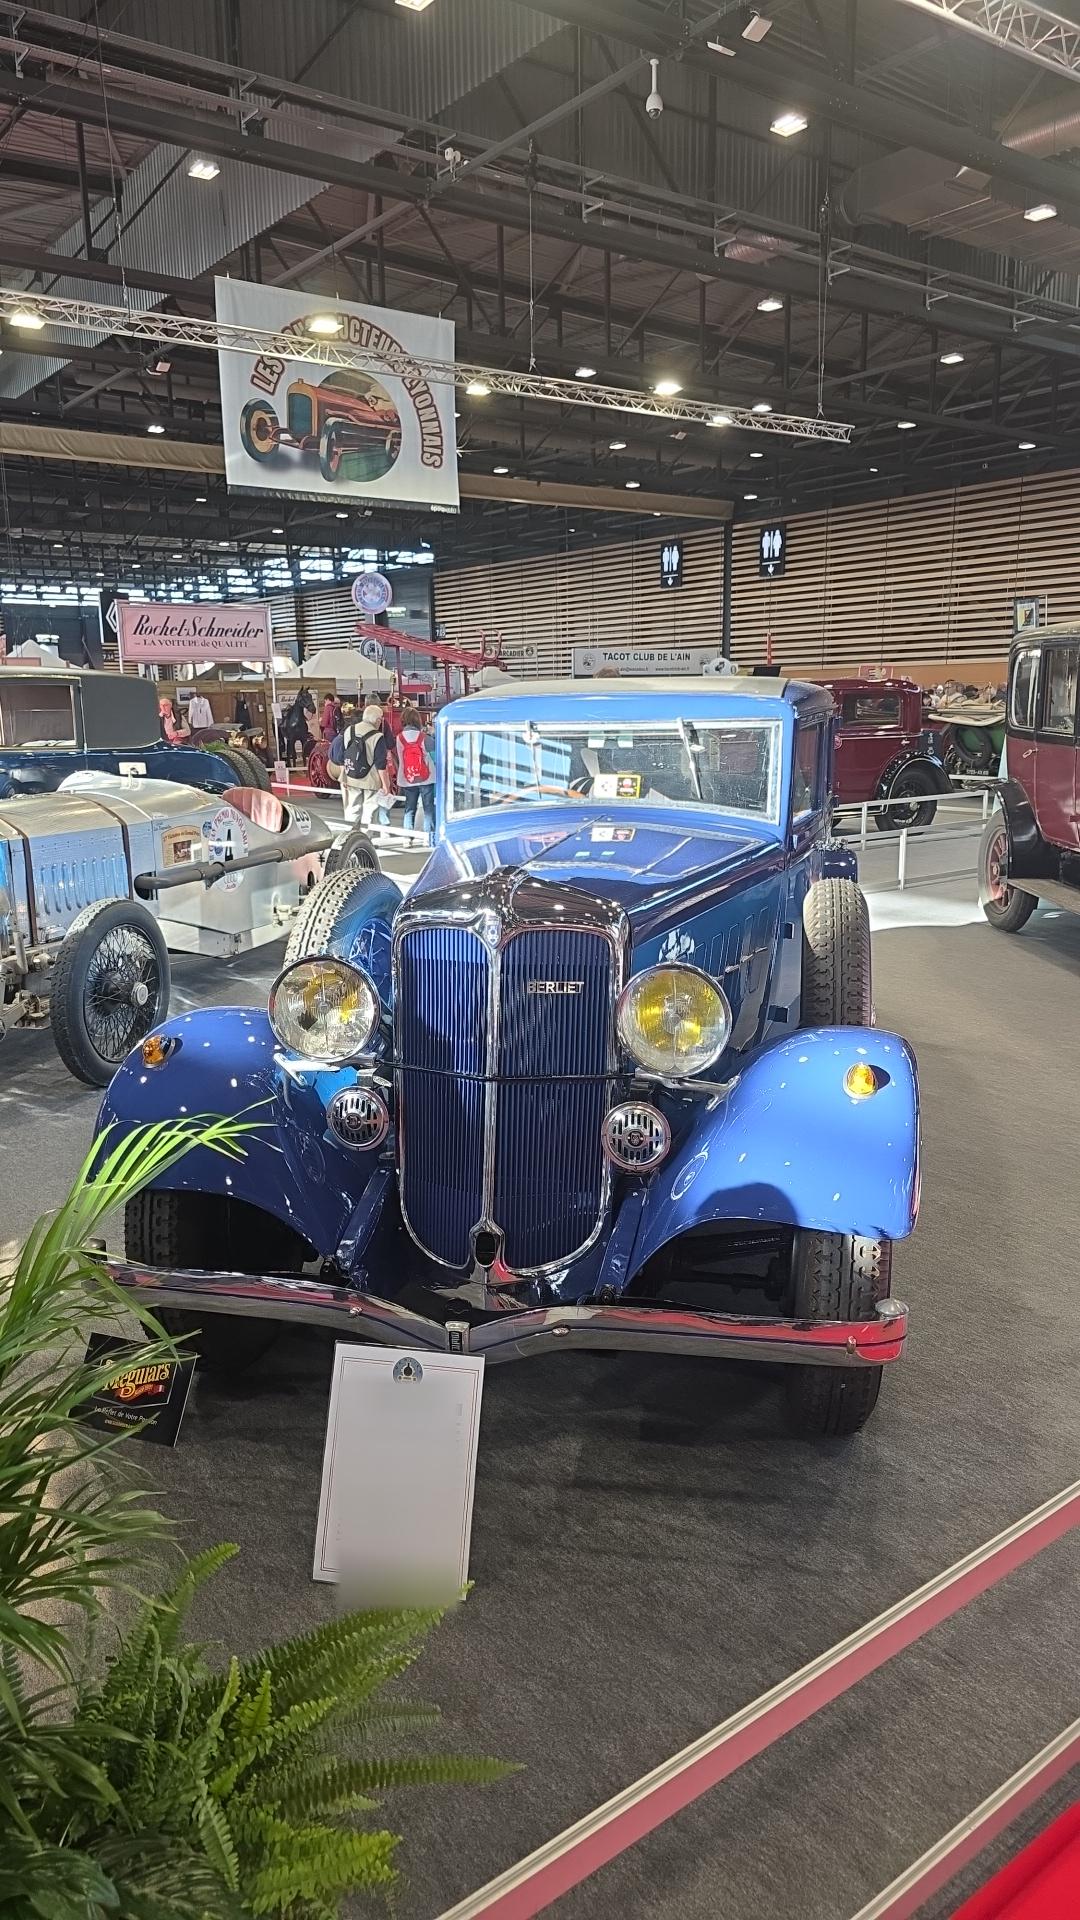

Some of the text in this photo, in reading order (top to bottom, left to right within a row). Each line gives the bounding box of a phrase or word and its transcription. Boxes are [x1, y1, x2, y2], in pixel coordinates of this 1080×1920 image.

[250, 351, 286, 396] LES
[132, 614, 264, 639] Rochet-Schneider
[143, 639, 157, 647] LA
[201, 640, 210, 648] de
[602, 652, 691, 661] TACOT CLUB DE L'AIN
[527, 979, 585, 994] BERLIET
